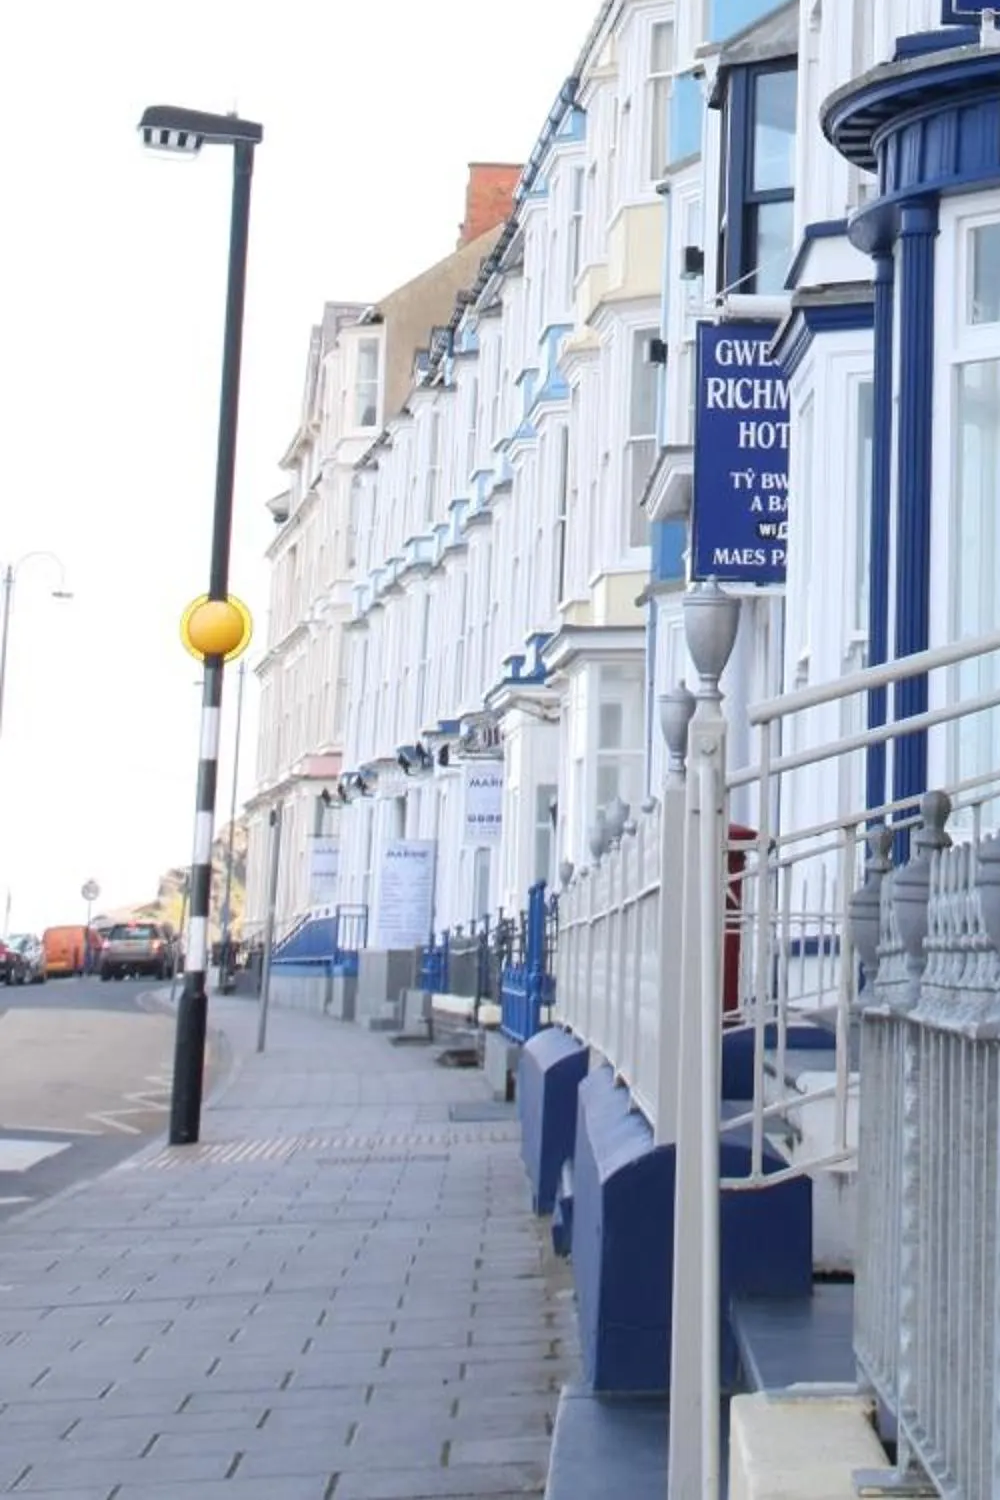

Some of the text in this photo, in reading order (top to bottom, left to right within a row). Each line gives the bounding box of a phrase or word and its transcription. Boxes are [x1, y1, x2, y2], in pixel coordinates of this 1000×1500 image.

[715, 339, 782, 367] GWE
[750, 495, 763, 512] A
[713, 547, 767, 566] MAES
